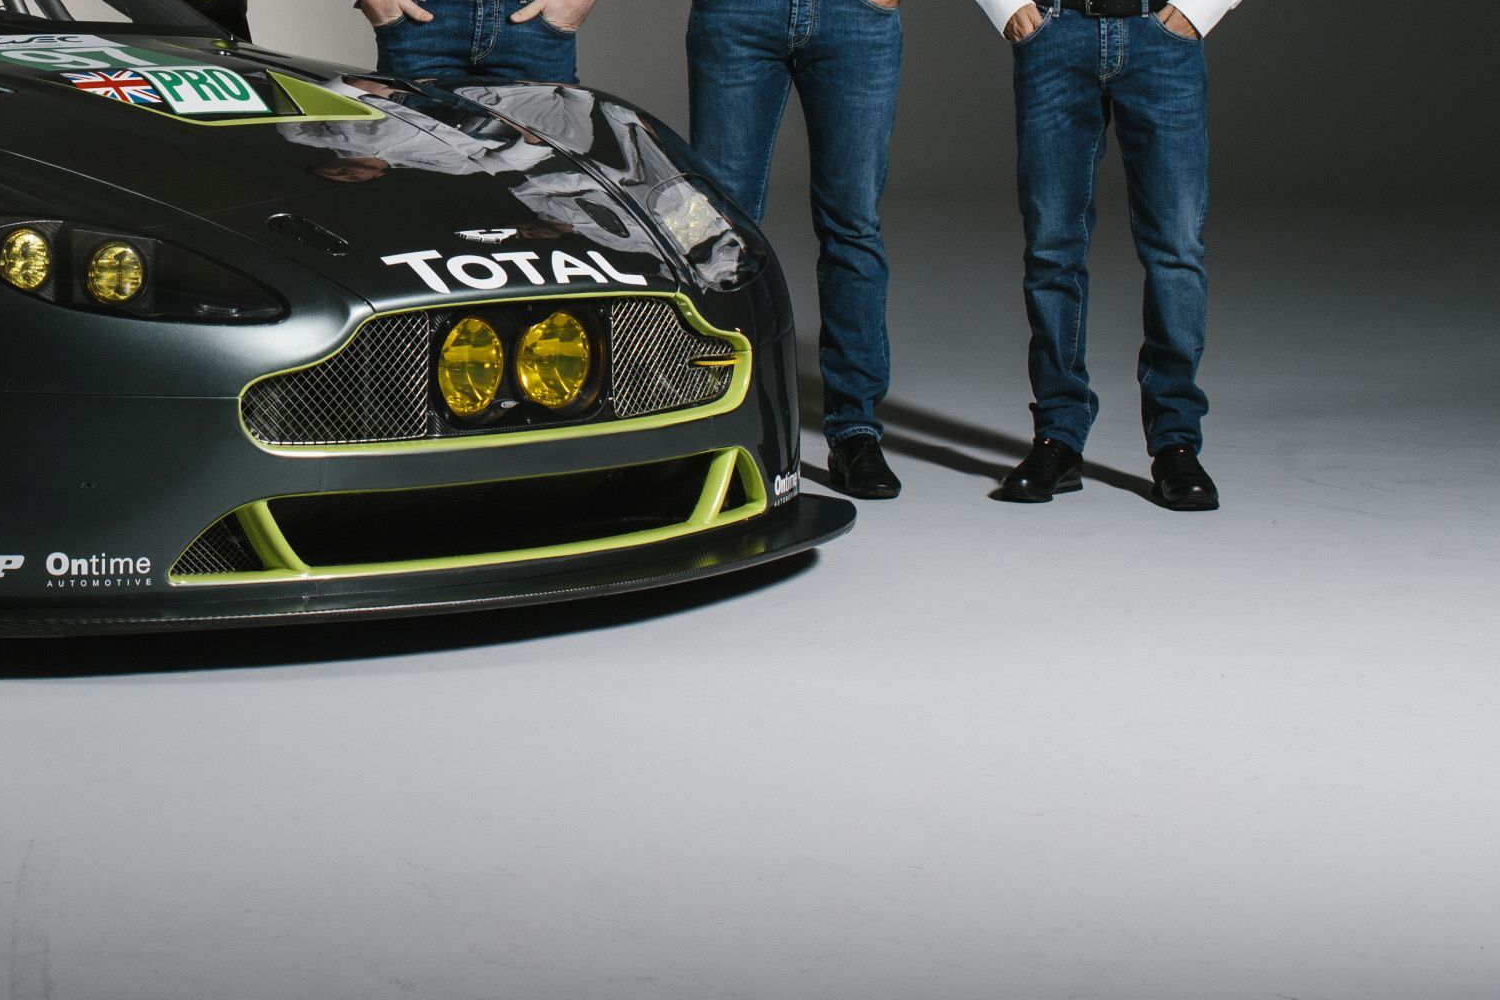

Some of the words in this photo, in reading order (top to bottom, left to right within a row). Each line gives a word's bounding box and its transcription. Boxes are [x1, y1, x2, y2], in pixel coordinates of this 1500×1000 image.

[0, 47, 159, 70] 97
[152, 68, 252, 102] PRO
[380, 249, 649, 294] TOTAL
[46, 552, 151, 576] Ontime
[47, 579, 152, 587] AUTOMOTIVE
